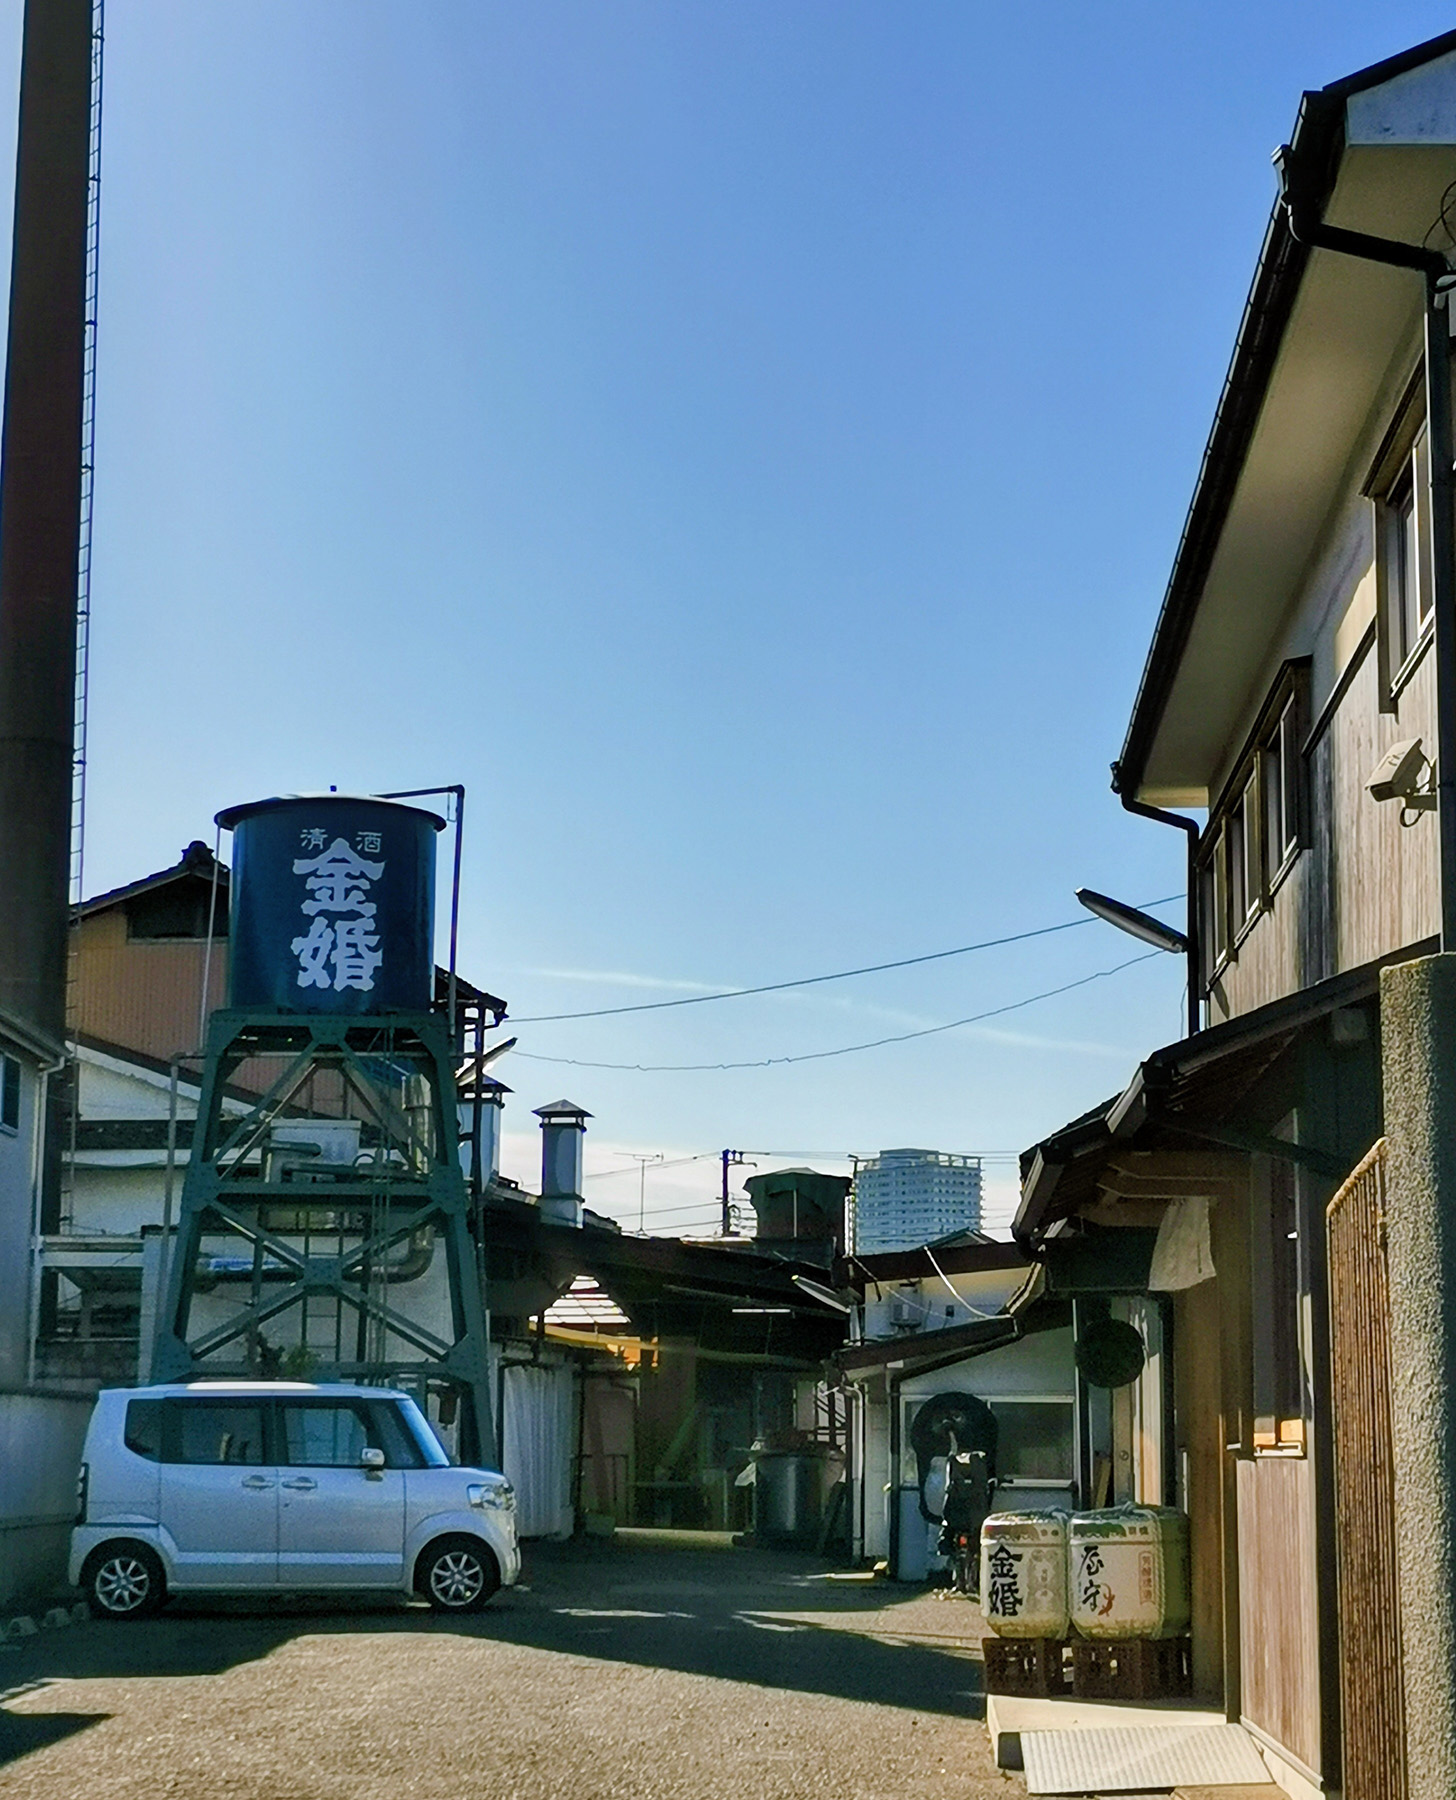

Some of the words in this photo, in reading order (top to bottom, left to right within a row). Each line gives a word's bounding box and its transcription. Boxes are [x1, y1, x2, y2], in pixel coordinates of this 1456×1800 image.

[300, 828, 382, 852] 清酒
[291, 838, 385, 991] 金婚
[988, 1545, 1023, 1617] 金婚
